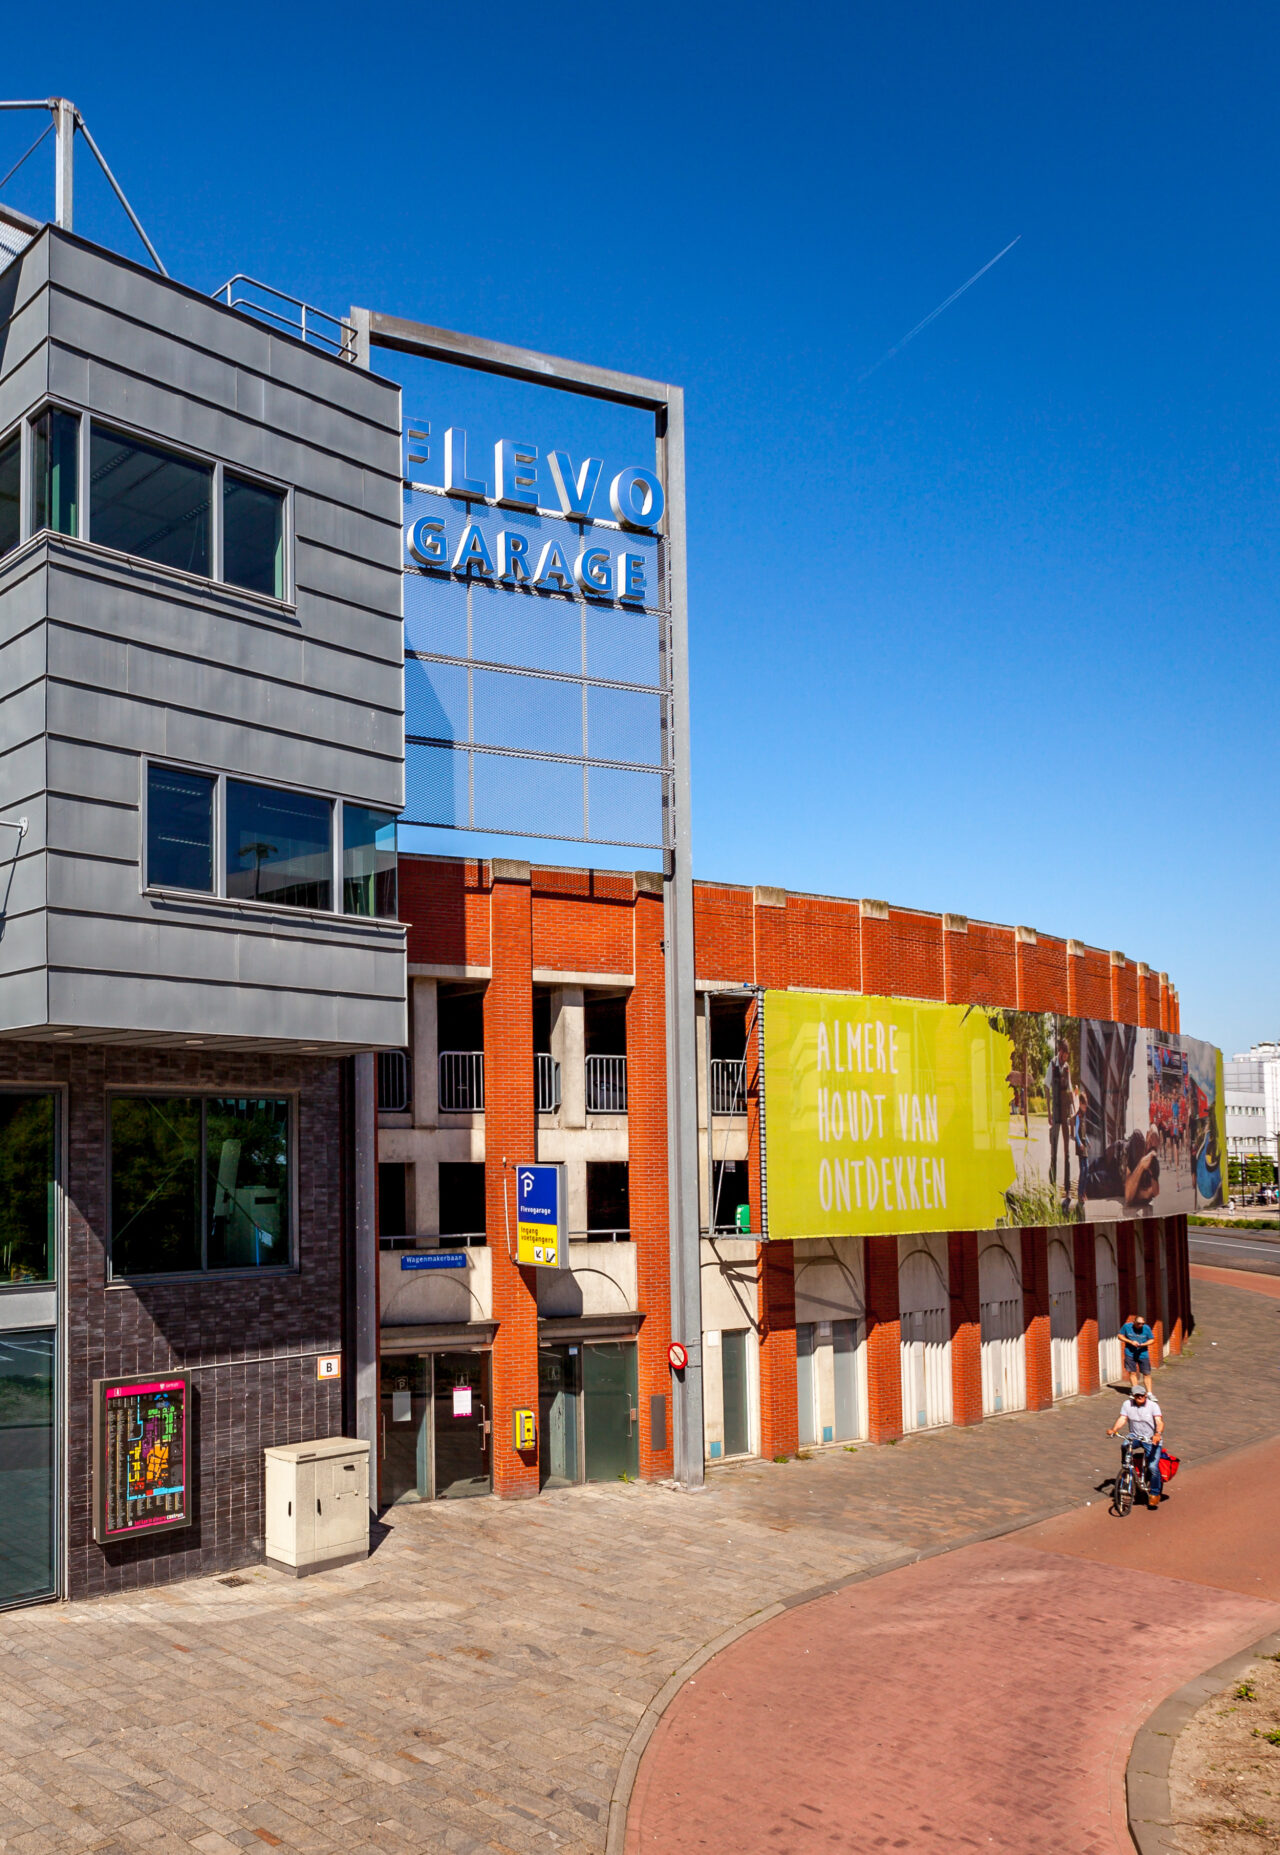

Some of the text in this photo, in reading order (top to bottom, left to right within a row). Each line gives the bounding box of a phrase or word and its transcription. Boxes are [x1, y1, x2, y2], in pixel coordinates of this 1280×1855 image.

[403, 416, 665, 528] FLEVO
[407, 516, 646, 601] GARAGE
[817, 1020, 899, 1074] ALMERE
[818, 1087, 939, 1142] HOUDT VAN
[520, 1205, 551, 1215] Flevogarage
[819, 1156, 947, 1212] ONTDEKKEN
[521, 1226, 539, 1236] Ingang
[521, 1234, 554, 1244] voetgangers
[326, 1362, 333, 1373] B
